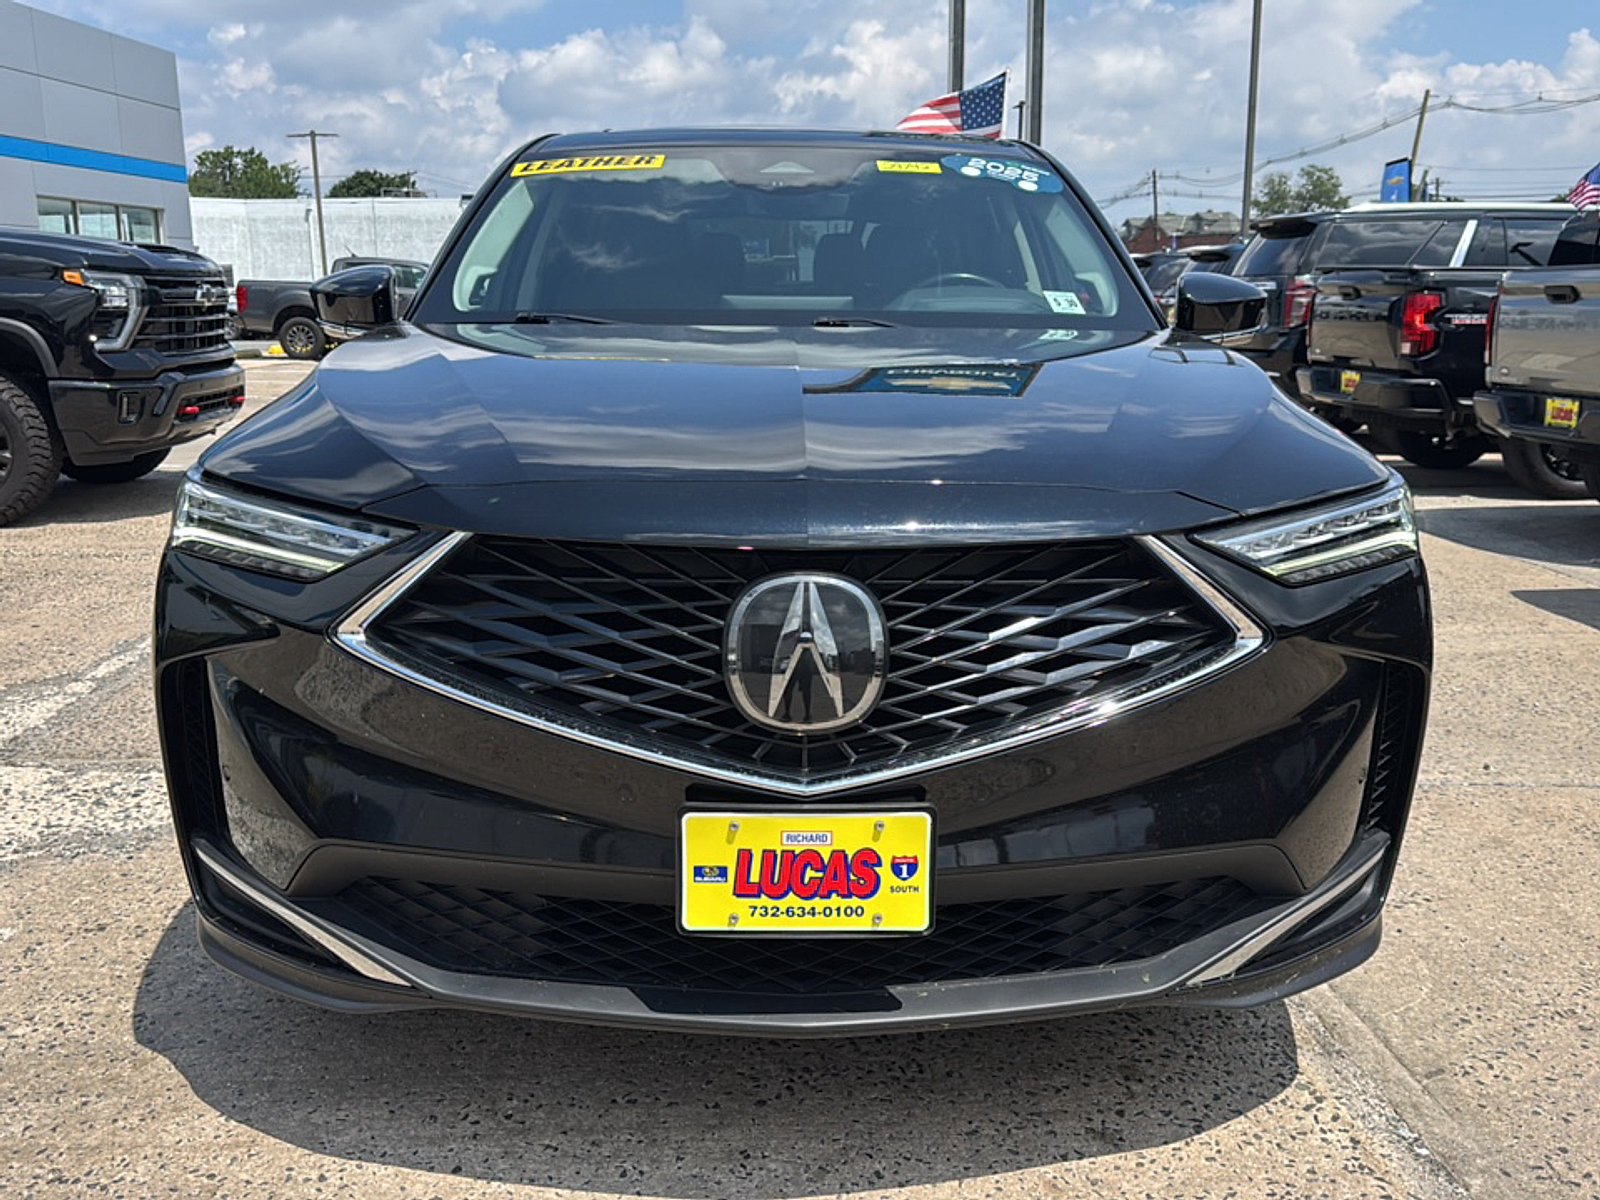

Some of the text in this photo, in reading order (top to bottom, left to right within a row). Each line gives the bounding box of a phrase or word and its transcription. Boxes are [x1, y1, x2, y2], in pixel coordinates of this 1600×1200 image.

[520, 156, 657, 172] LEATHER
[968, 158, 1040, 181] 2025
[786, 834, 829, 843] RICHARD
[733, 847, 883, 900] LUCAS
[899, 863, 909, 878] 1
[890, 885, 919, 893] SOUTH
[749, 905, 865, 918] 732-634-0100
